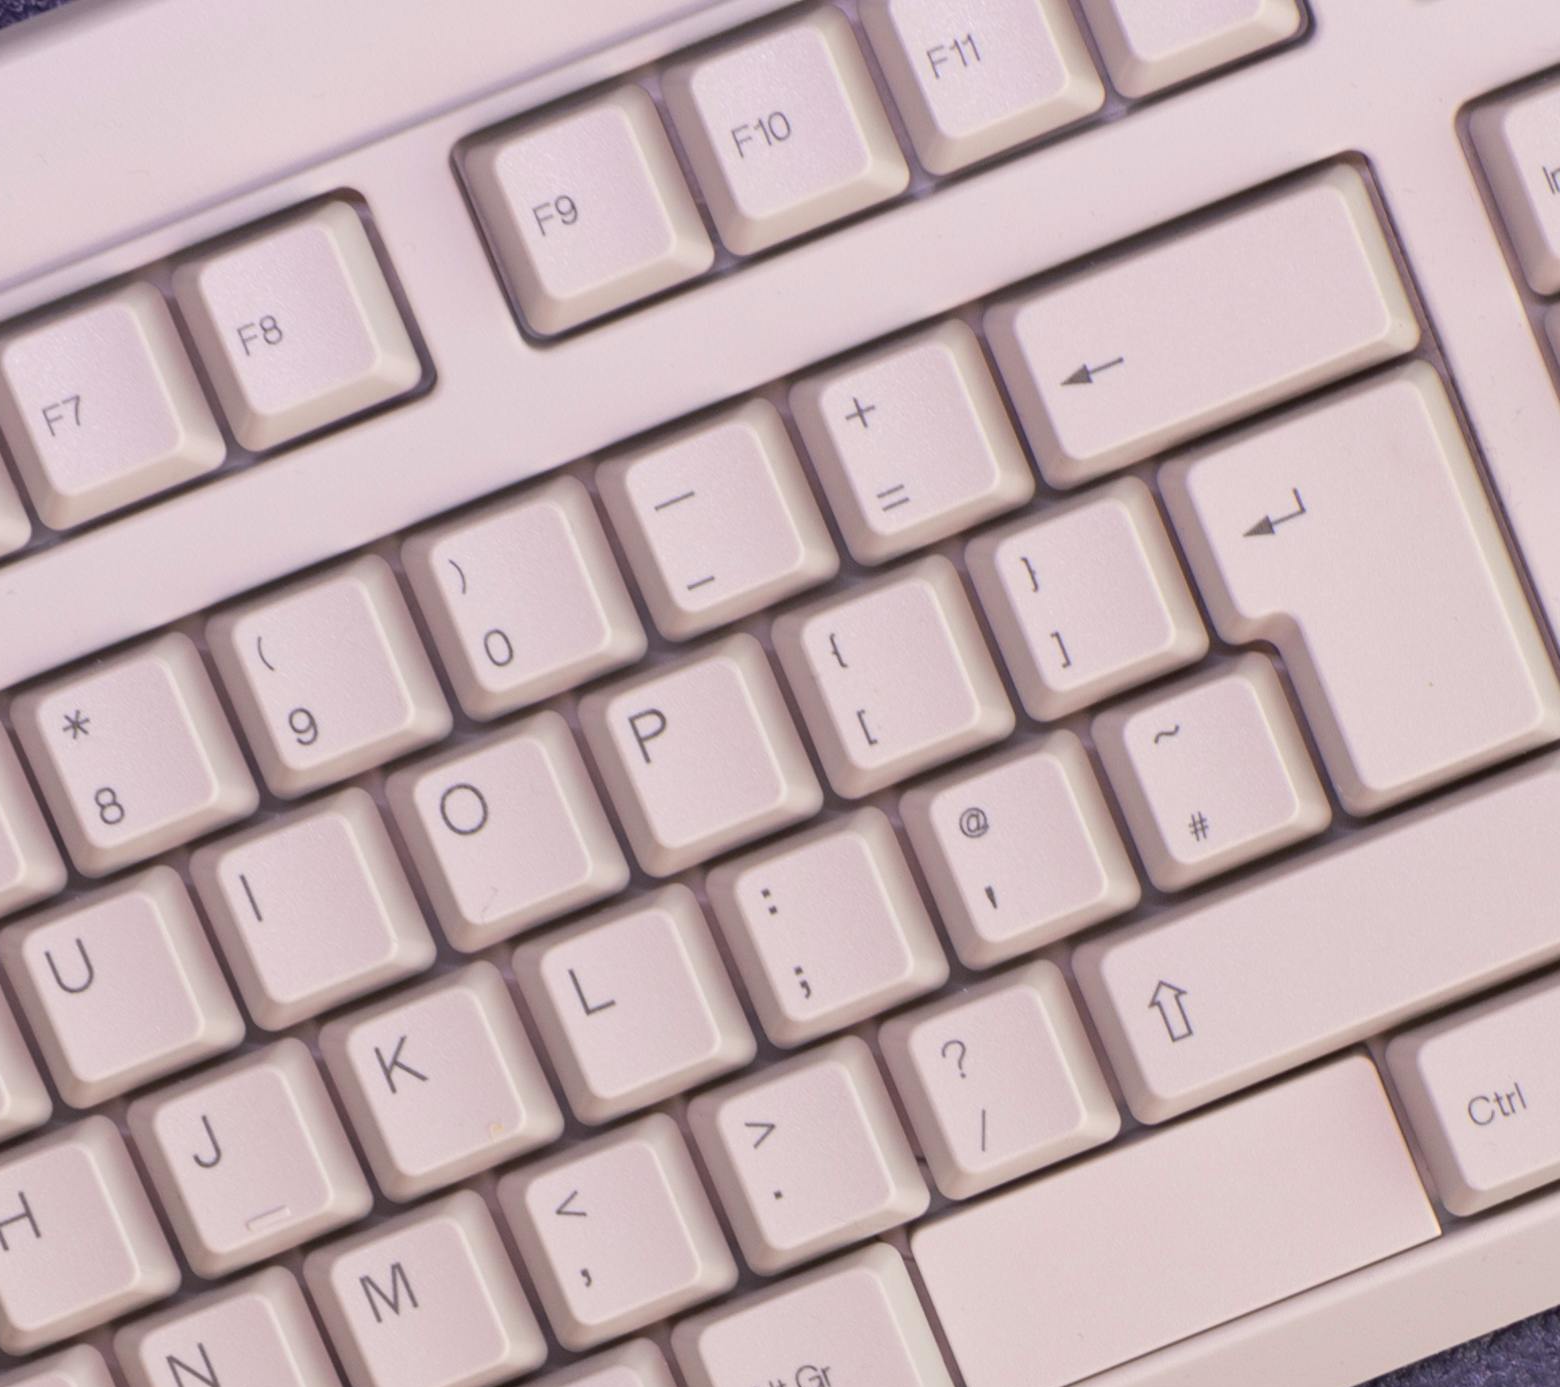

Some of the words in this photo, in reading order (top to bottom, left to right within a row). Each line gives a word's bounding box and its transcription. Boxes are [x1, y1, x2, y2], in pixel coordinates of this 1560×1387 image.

[926, 33, 981, 80] F11
[730, 111, 792, 159] F10
[532, 194, 579, 237] F9
[236, 314, 284, 357] F8
[41, 394, 81, 437] F7
[483, 628, 515, 668] 0
[288, 707, 319, 747] 9
[627, 708, 668, 764] P
[93, 786, 126, 826] 8
[439, 782, 489, 837] O
[44, 937, 95, 995] U
[567, 968, 617, 1017] L
[373, 1035, 429, 1095] K
[1467, 1082, 1527, 1127] Ctrl
[192, 1114, 223, 1169] J
[359, 1261, 419, 1324] M
